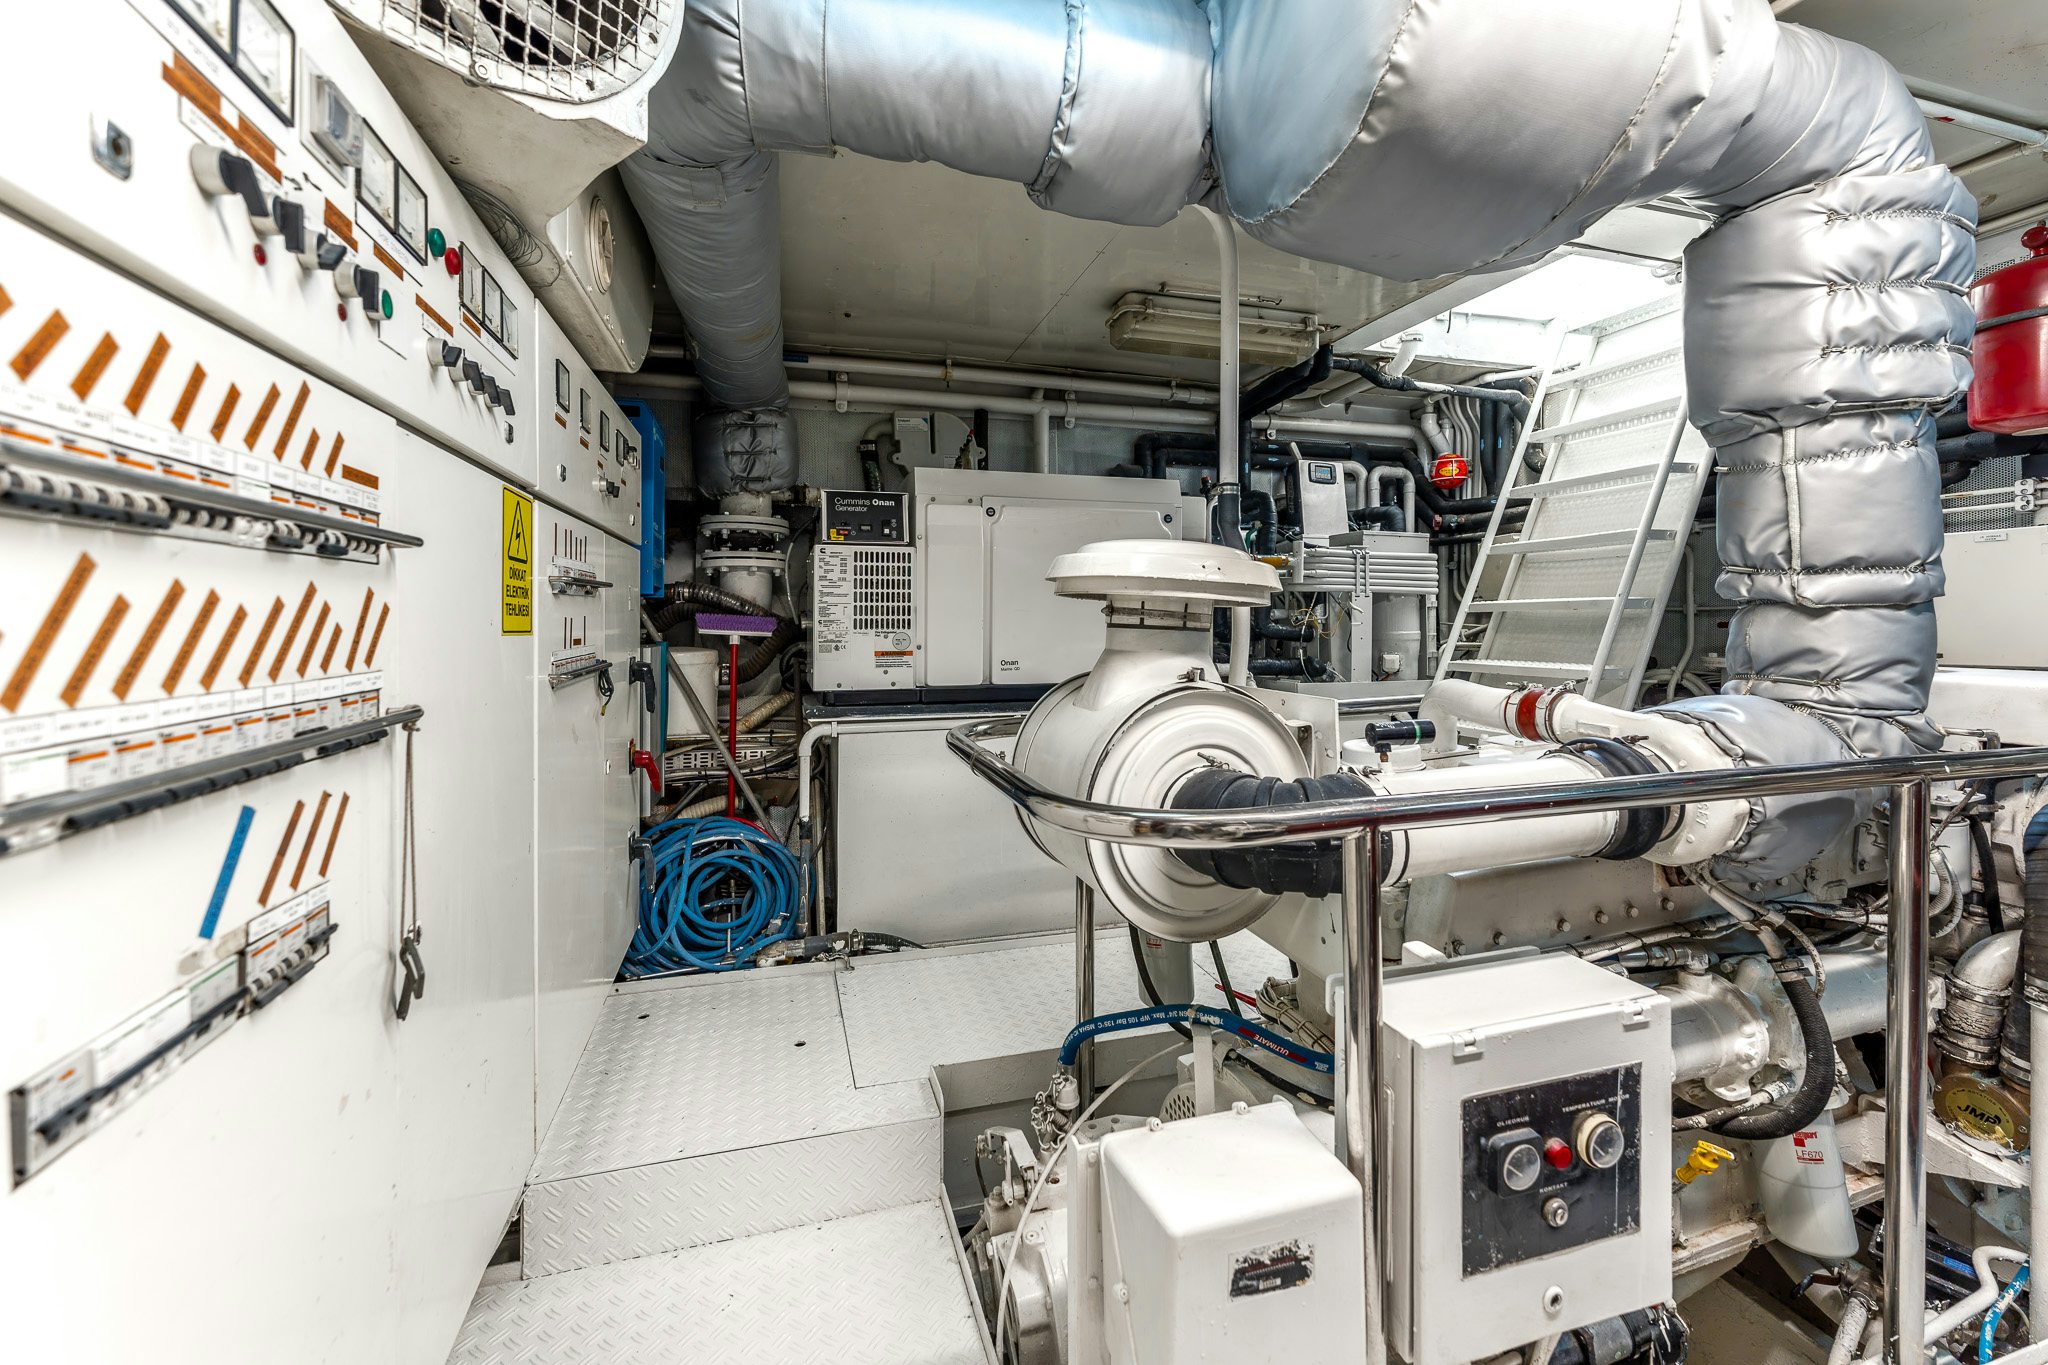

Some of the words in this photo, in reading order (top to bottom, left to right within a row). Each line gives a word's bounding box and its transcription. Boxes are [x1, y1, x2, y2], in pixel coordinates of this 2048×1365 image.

[834, 497, 870, 506] Cummins
[872, 498, 895, 507] Onan
[509, 564, 527, 582] DİKKAT
[505, 601, 530, 617] TEHLİKESİ
[1127, 1016, 1139, 1024] 105
[1078, 1024, 1096, 1033] MSHA
[1253, 1033, 1289, 1056] ULTIMATE
[1956, 1104, 2000, 1126] JMP
[1795, 1149, 1824, 1159] LF670
[1539, 1181, 1568, 1194] KONTAKT
